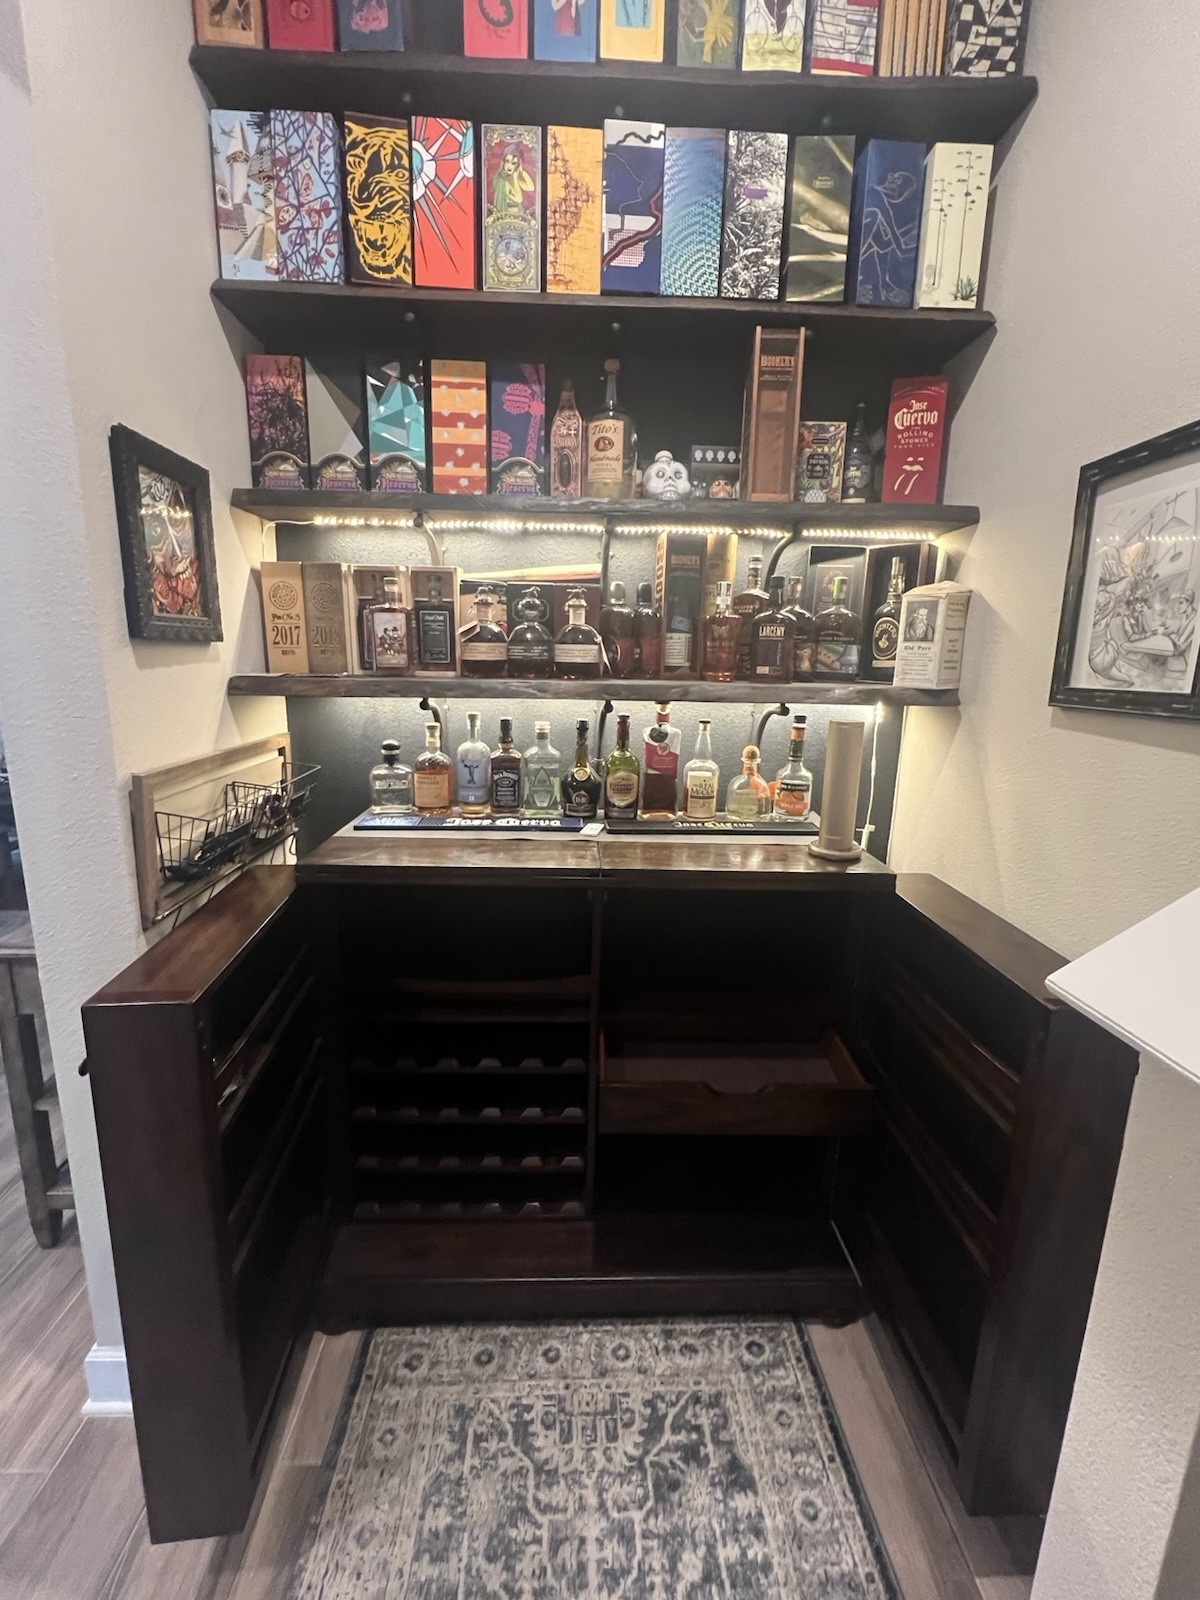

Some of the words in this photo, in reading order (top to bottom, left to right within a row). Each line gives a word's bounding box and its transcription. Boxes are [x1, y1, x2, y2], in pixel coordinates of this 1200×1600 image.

[909, 400, 928, 413] Jose
[894, 408, 939, 430] Cuervo
[592, 424, 620, 435] Tito's
[897, 430, 934, 439] ROLLING
[272, 625, 301, 646] 2017
[759, 626, 785, 637] LARCENY
[442, 817, 494, 827] Jose
[495, 817, 562, 827] Cuervo
[703, 820, 755, 830] Cuervo
